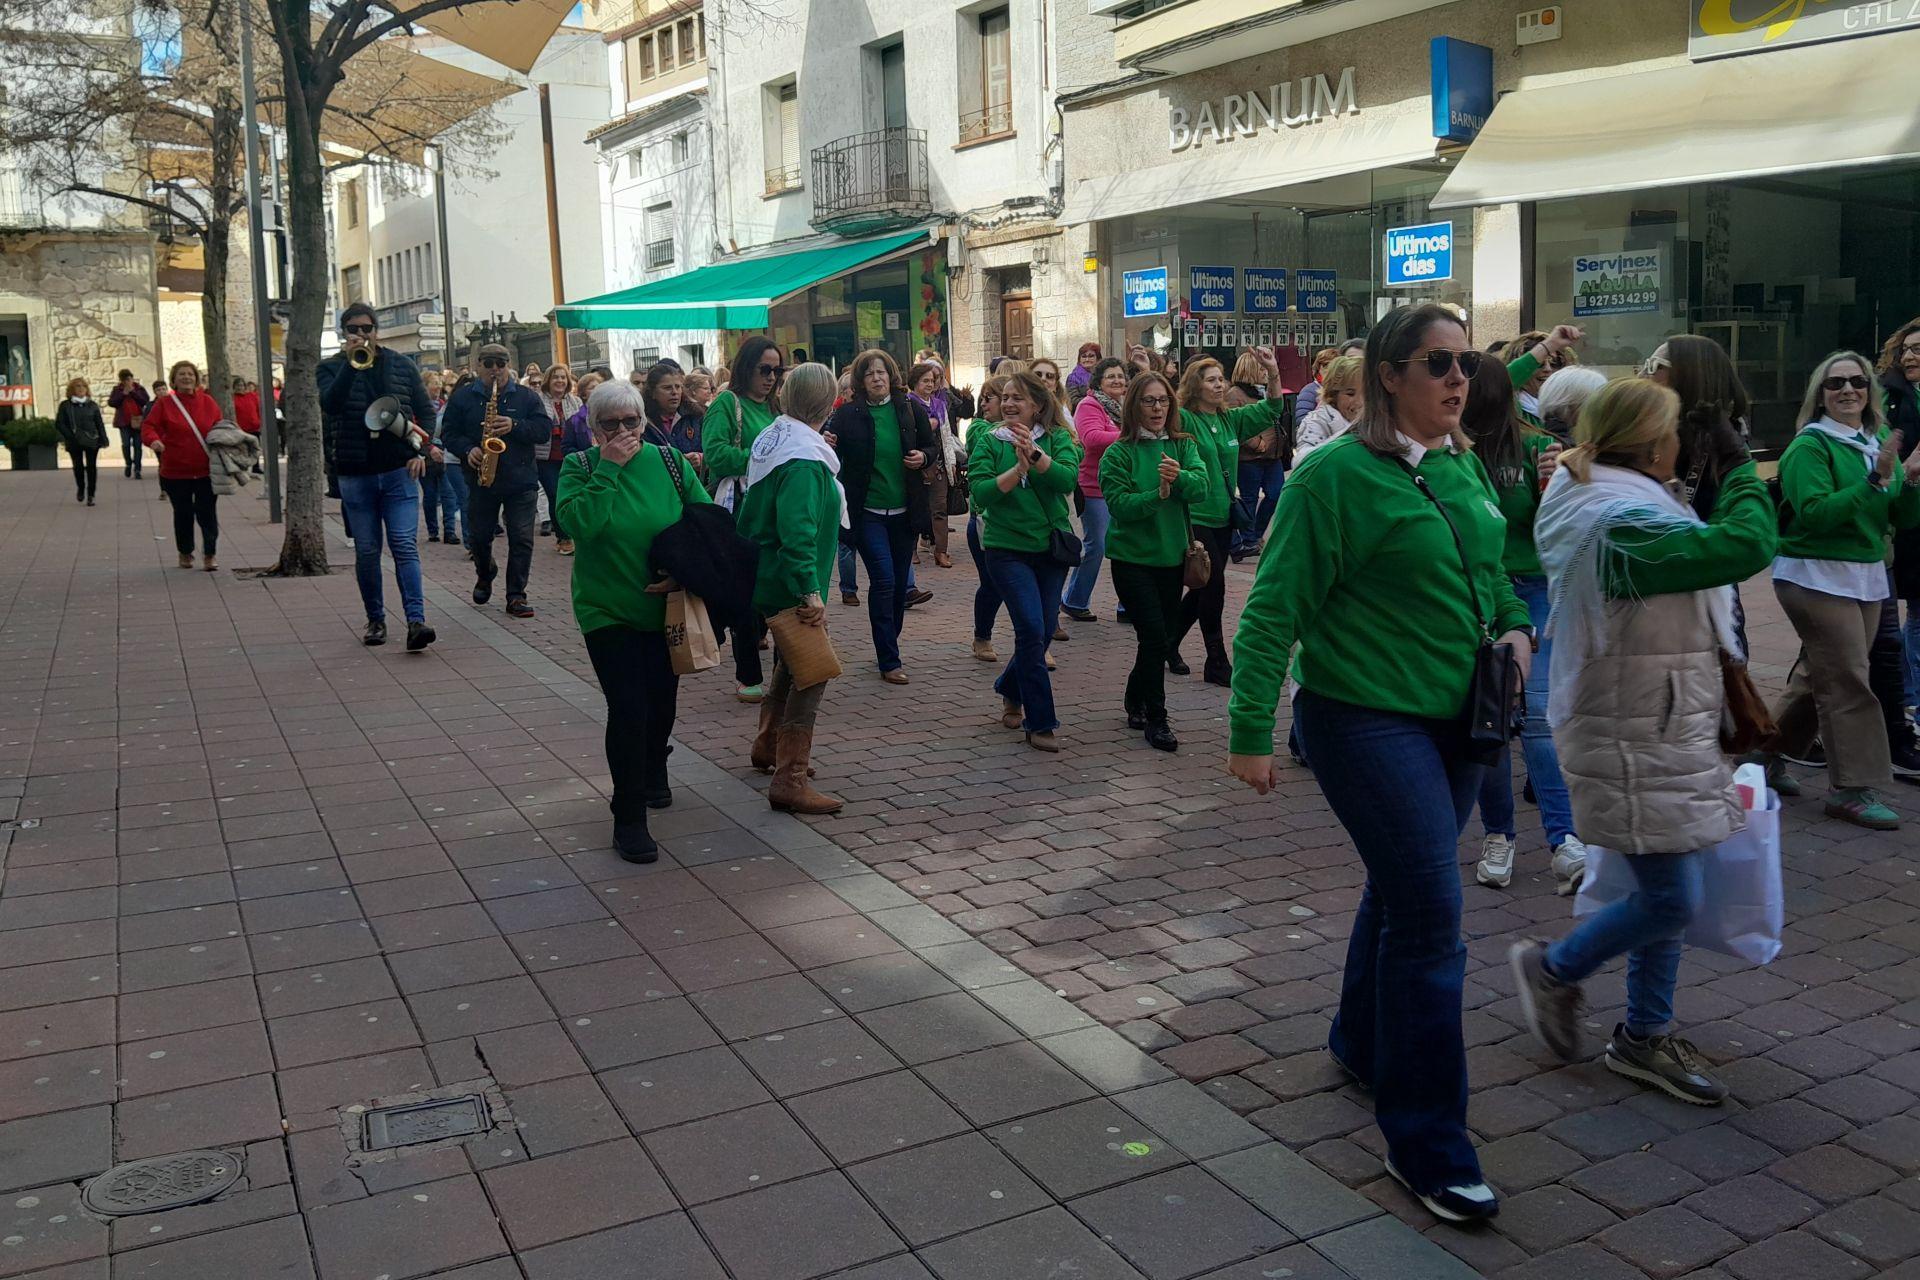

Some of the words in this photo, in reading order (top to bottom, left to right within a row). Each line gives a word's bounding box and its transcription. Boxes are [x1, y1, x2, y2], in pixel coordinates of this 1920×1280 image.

[1168, 66, 1360, 150] BARNUM
[1389, 231, 1450, 257] Últimos
[1402, 255, 1436, 277] días
[1576, 254, 1657, 274] Servinex
[1125, 273, 1166, 294] Últimos
[1191, 268, 1234, 290] Últimos
[1245, 269, 1285, 291] Últimos
[1297, 271, 1336, 291] Últimos
[1578, 272, 1655, 295] ALQUILA
[1134, 294, 1158, 311] días
[1200, 290, 1225, 307] días
[1254, 292, 1277, 308] días
[1306, 292, 1328, 308] días
[1589, 295, 1609, 307] 927
[1611, 294, 1625, 306] 53
[1626, 292, 1640, 304] 42
[1642, 291, 1657, 303] 99
[1188, 335, 1195, 345] 10
[1207, 335, 1213, 345] 10
